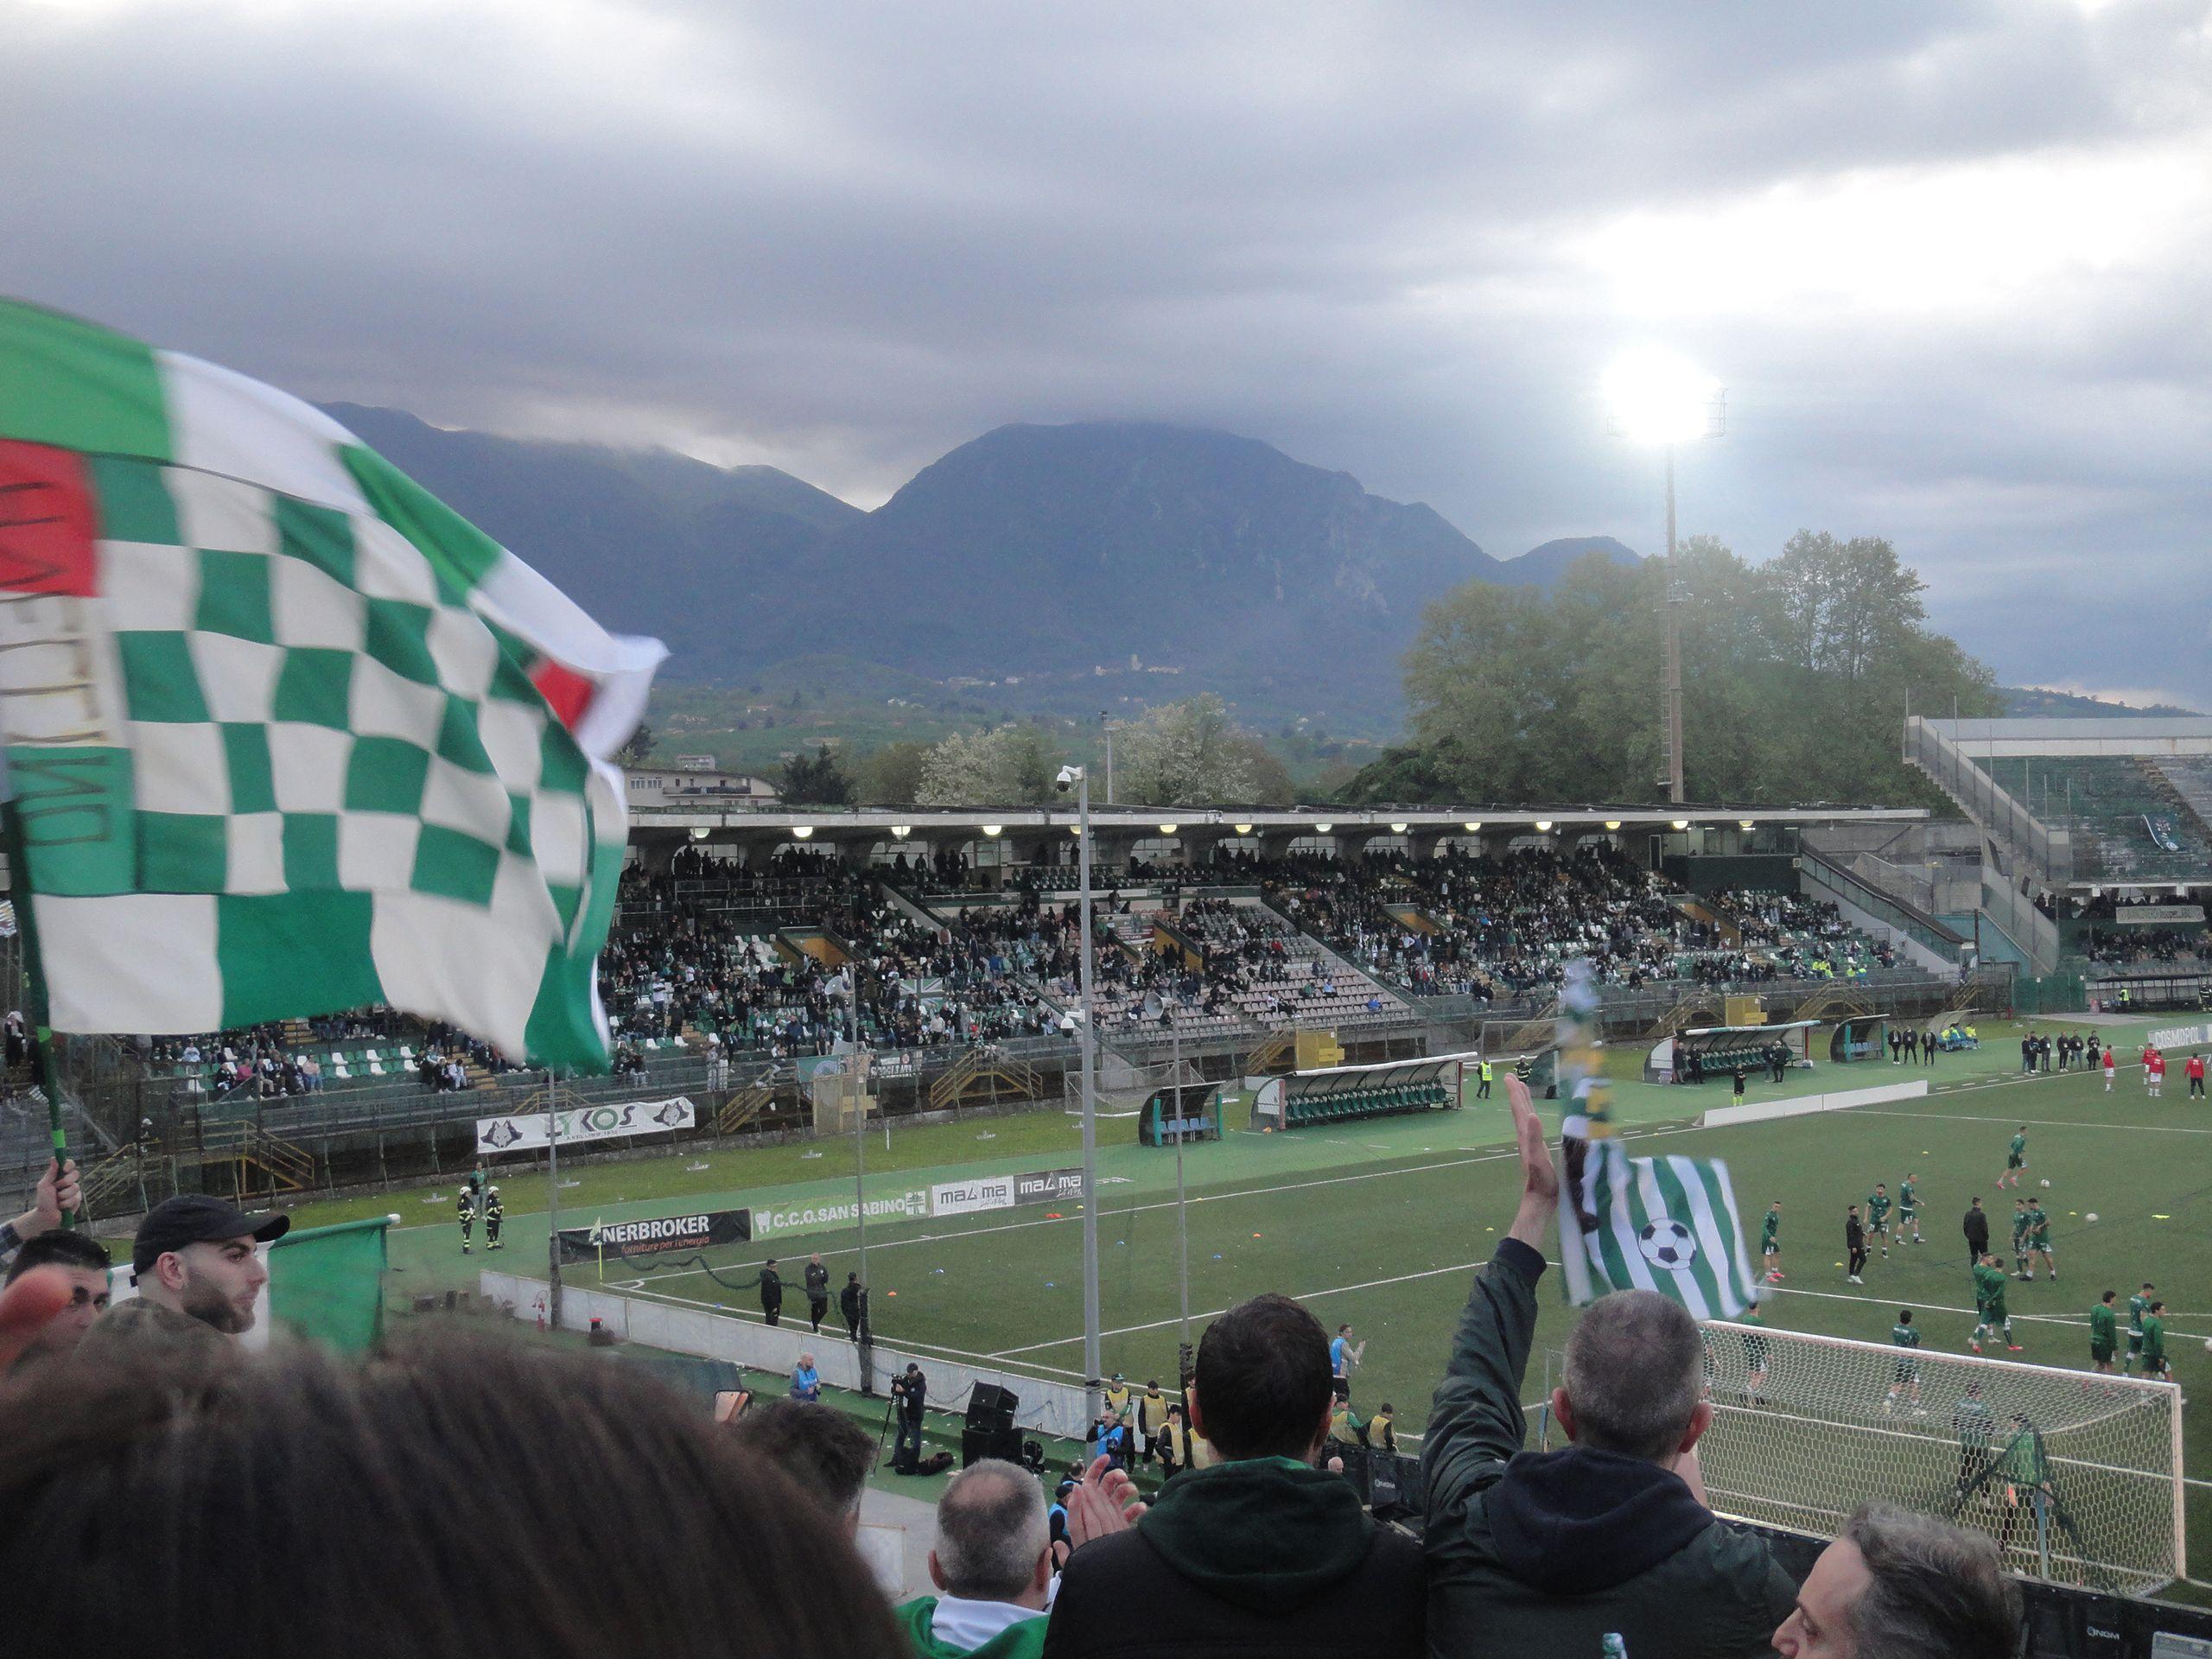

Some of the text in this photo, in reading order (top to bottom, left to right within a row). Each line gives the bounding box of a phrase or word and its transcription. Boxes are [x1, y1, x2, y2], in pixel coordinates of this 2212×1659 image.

[2155, 1027, 2202, 1047] COSMOPOL
[850, 1198, 906, 1218] SABINO
[593, 1215, 710, 1246] NERBROKER
